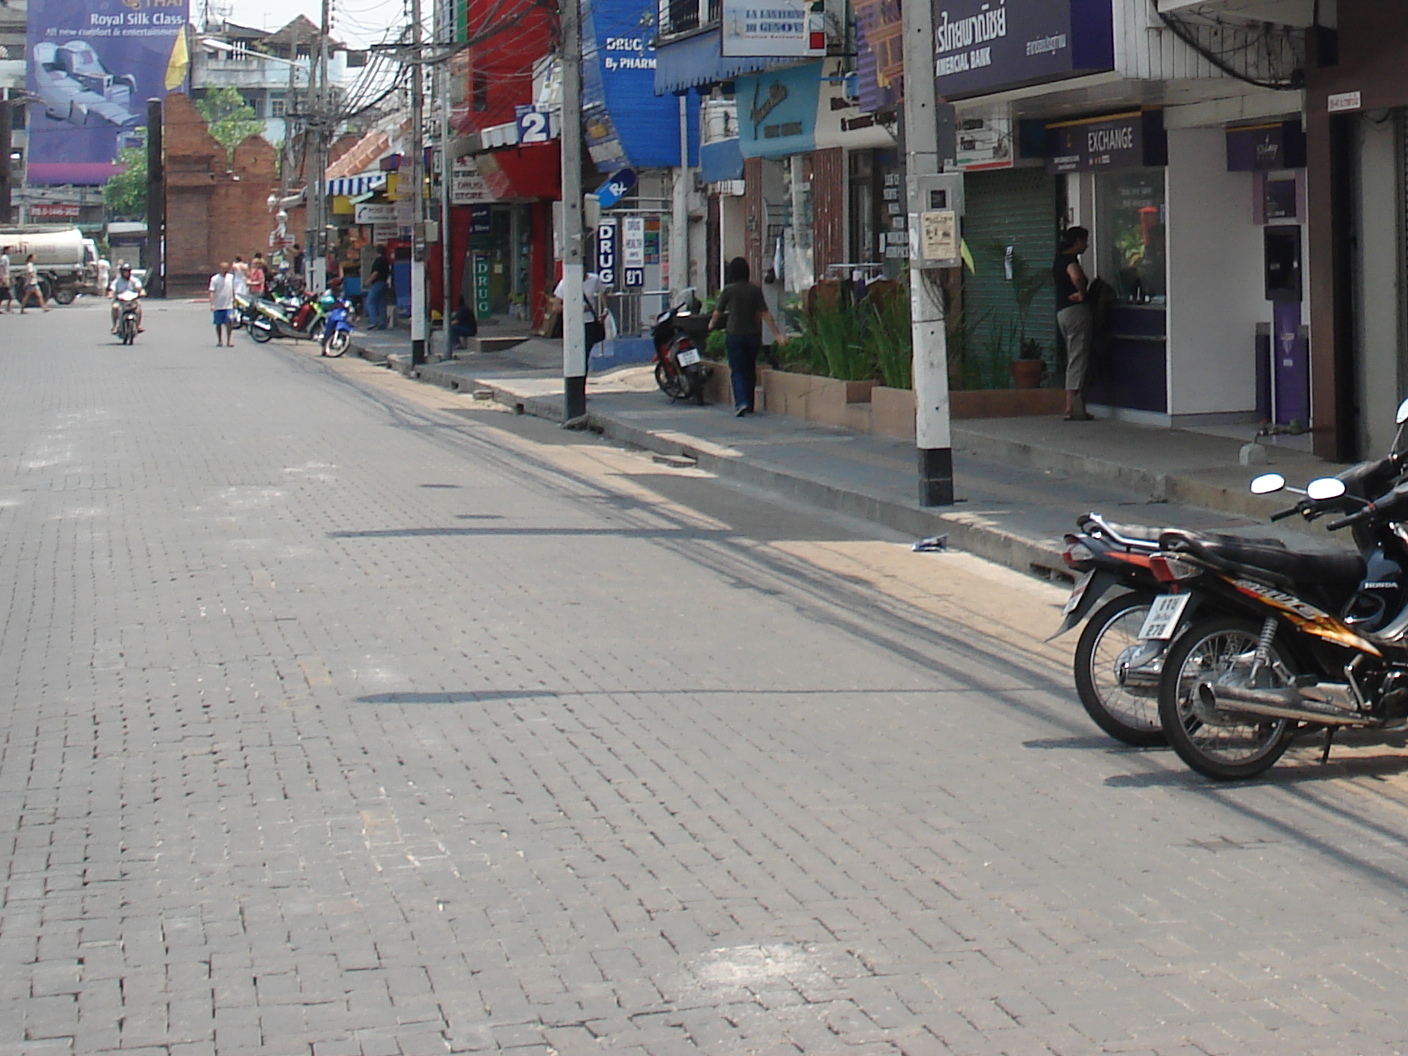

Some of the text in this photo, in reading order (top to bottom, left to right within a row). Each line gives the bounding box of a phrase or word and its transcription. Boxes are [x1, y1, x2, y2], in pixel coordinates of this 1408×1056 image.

[90, 13, 123, 28] Royal
[127, 12, 149, 25] Silk
[760, 22, 804, 33] GENOV
[122, 28, 179, 36] entertainmen
[606, 37, 642, 51] DRUG
[605, 57, 657, 72] By PHARM
[970, 46, 992, 70] BANK
[522, 113, 547, 143] 2
[1088, 127, 1133, 152] EXCHANGE
[600, 226, 614, 283] DRUG
[626, 269, 642, 285] ยา
[477, 264, 489, 312] DRUG
